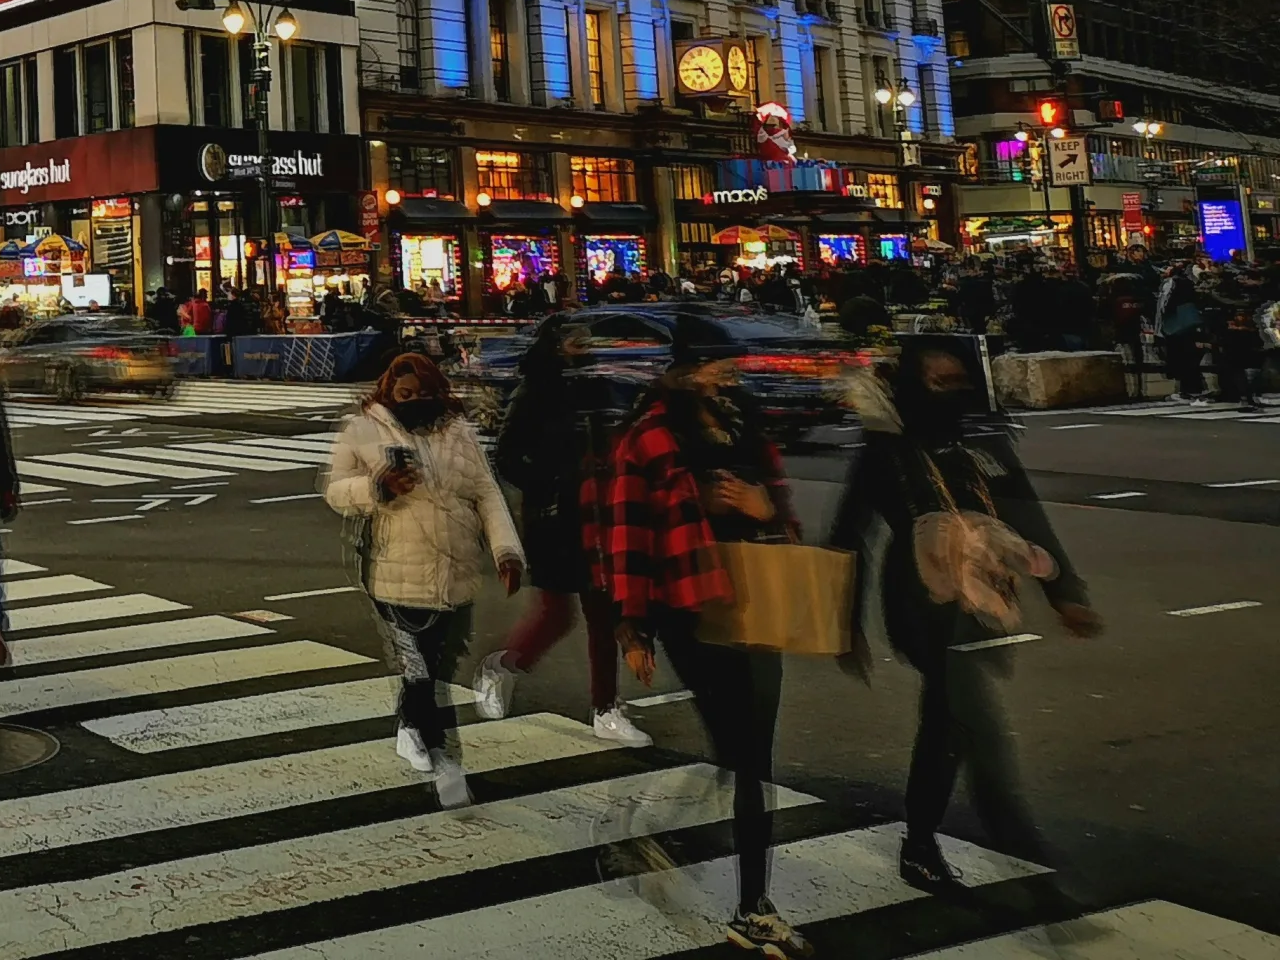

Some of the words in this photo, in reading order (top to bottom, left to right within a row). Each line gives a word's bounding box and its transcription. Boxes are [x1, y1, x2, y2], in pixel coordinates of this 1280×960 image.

[1053, 141, 1080, 152] KEEP
[297, 149, 324, 177] hut
[0, 161, 49, 194] sunglass
[49, 157, 71, 185] hut
[1055, 171, 1085, 182] RIGHT
[713, 185, 768, 205] macy's
